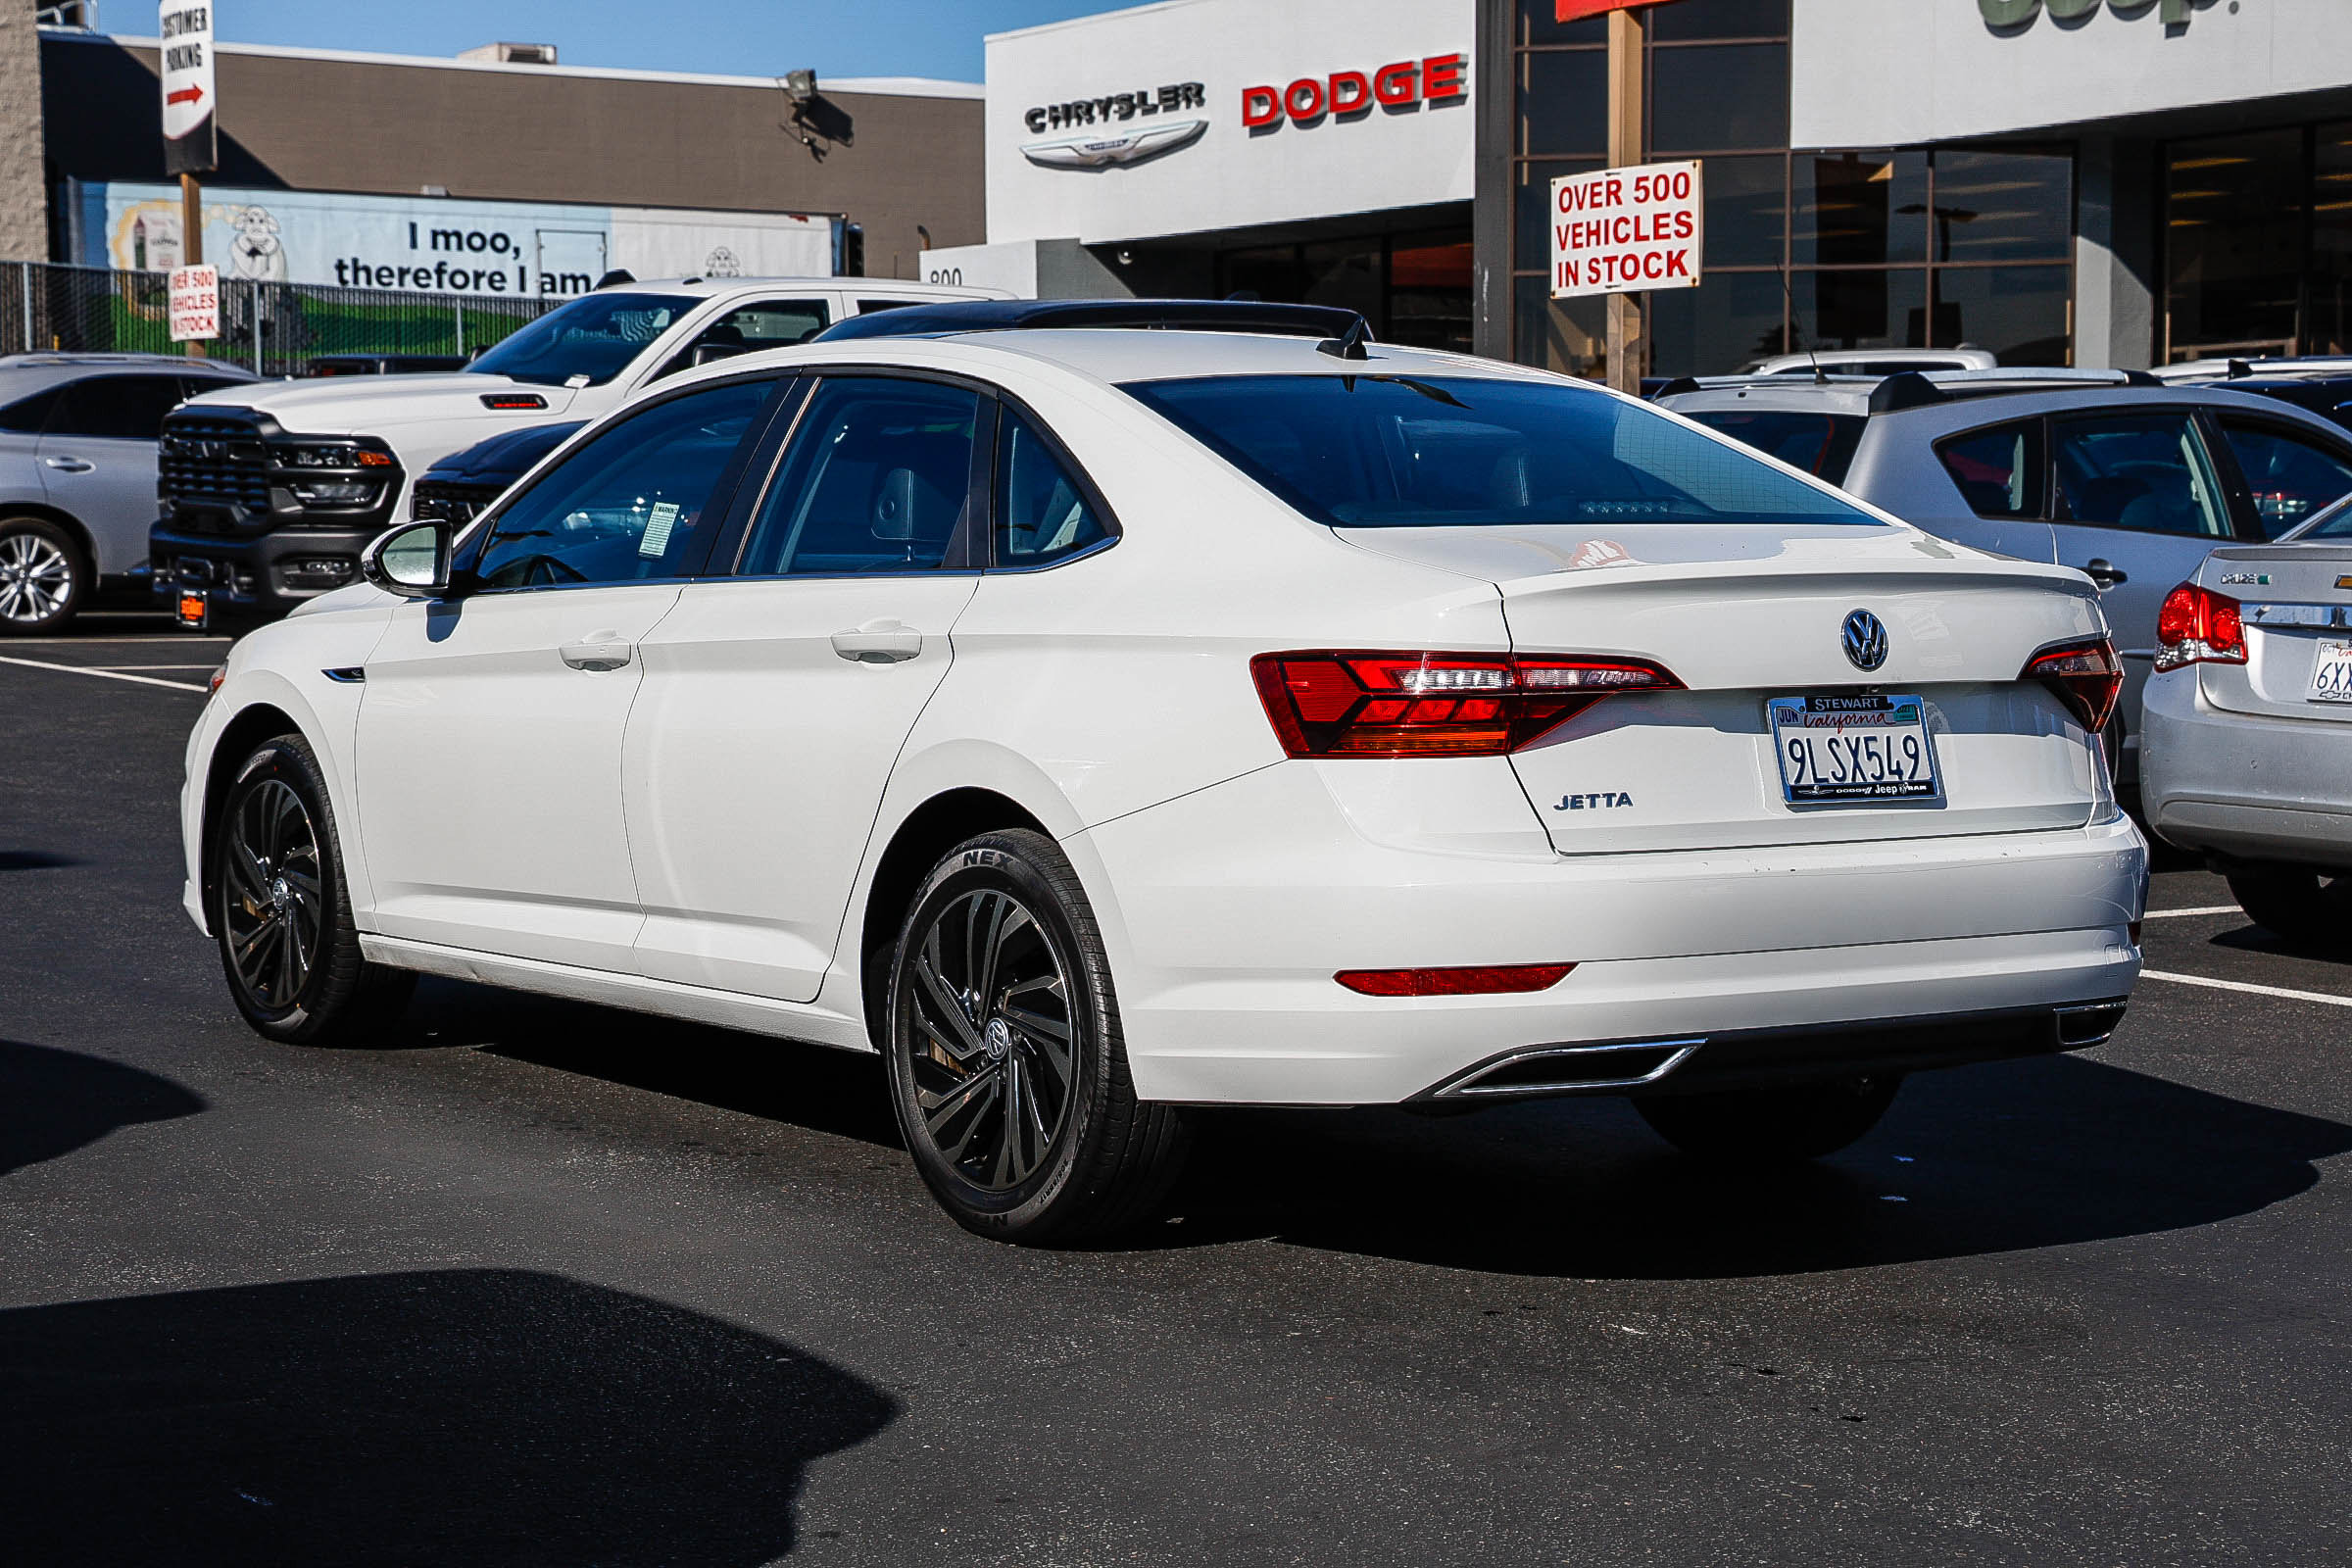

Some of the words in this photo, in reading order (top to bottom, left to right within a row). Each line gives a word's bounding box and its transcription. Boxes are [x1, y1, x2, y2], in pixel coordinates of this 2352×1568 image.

[1024, 81, 1206, 133] CHRYSLER
[1242, 53, 1467, 130] DODGE
[1559, 179, 1623, 213] OVER
[1634, 172, 1690, 204] 500
[409, 221, 418, 250] I
[431, 228, 521, 260] moo,
[1556, 211, 1693, 251] VEHICLES
[334, 257, 508, 291] therefore
[519, 266, 526, 292] I
[540, 271, 591, 293] am
[1558, 260, 1579, 288] IN
[1588, 249, 1689, 284] STOCK
[2220, 573, 2256, 585] CRUZE
[1779, 708, 1799, 723] JUN
[1815, 697, 1880, 711] STEWART
[1803, 712, 1897, 734] California
[1788, 735, 1921, 784] 9LSX549
[1552, 792, 1634, 810] JETTA
[1875, 784, 1898, 795] Jeep
